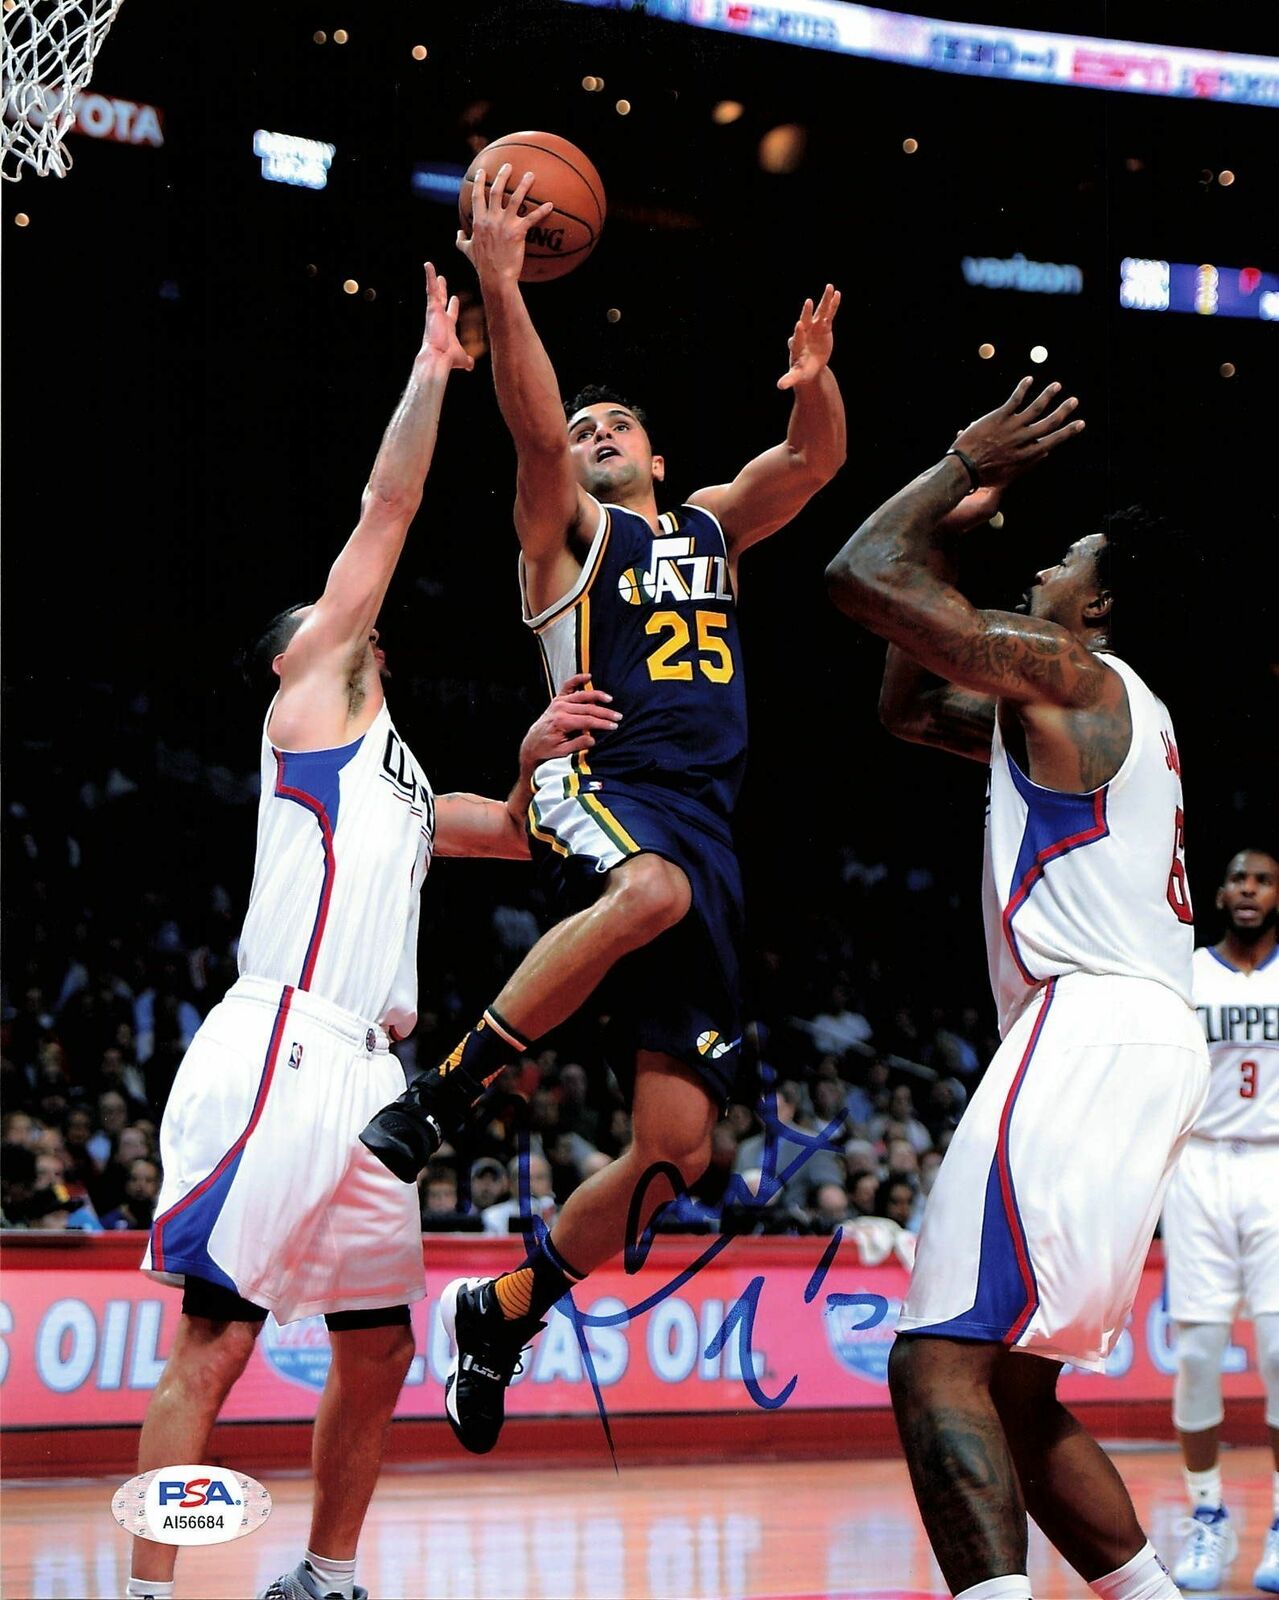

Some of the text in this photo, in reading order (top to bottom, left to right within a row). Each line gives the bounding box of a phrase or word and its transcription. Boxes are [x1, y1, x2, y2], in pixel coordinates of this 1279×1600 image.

[618, 537, 732, 604] JAZZ
[645, 610, 734, 684] 25
[1239, 1061, 1257, 1099] 3
[36, 1297, 169, 1392] OIL
